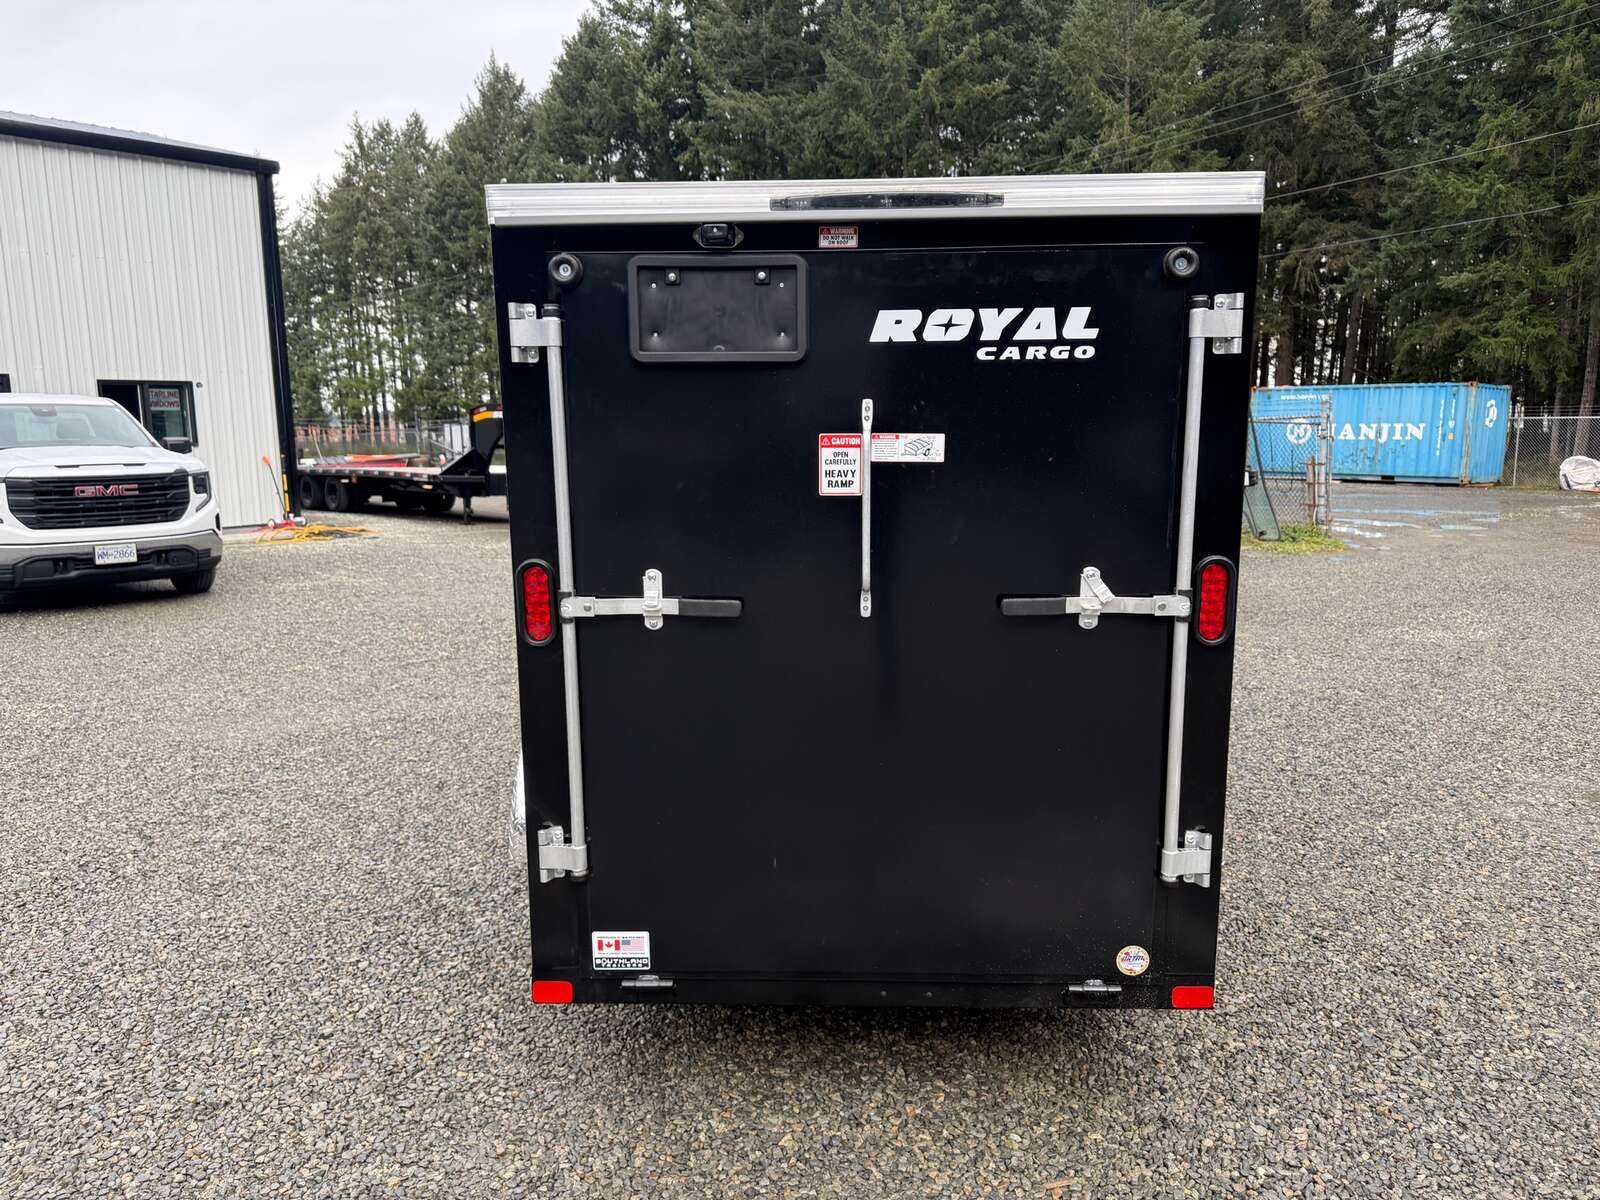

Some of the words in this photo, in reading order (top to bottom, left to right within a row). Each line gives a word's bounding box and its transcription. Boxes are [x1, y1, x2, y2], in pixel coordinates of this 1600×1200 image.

[869, 306, 1100, 343] ROYAL
[976, 345, 1097, 361] CARGO
[831, 437, 861, 445] CAUTION
[825, 458, 857, 466] CAREFULLY
[825, 469, 857, 478] HEAVY
[827, 480, 854, 488] RAMP
[74, 484, 139, 498] GMC
